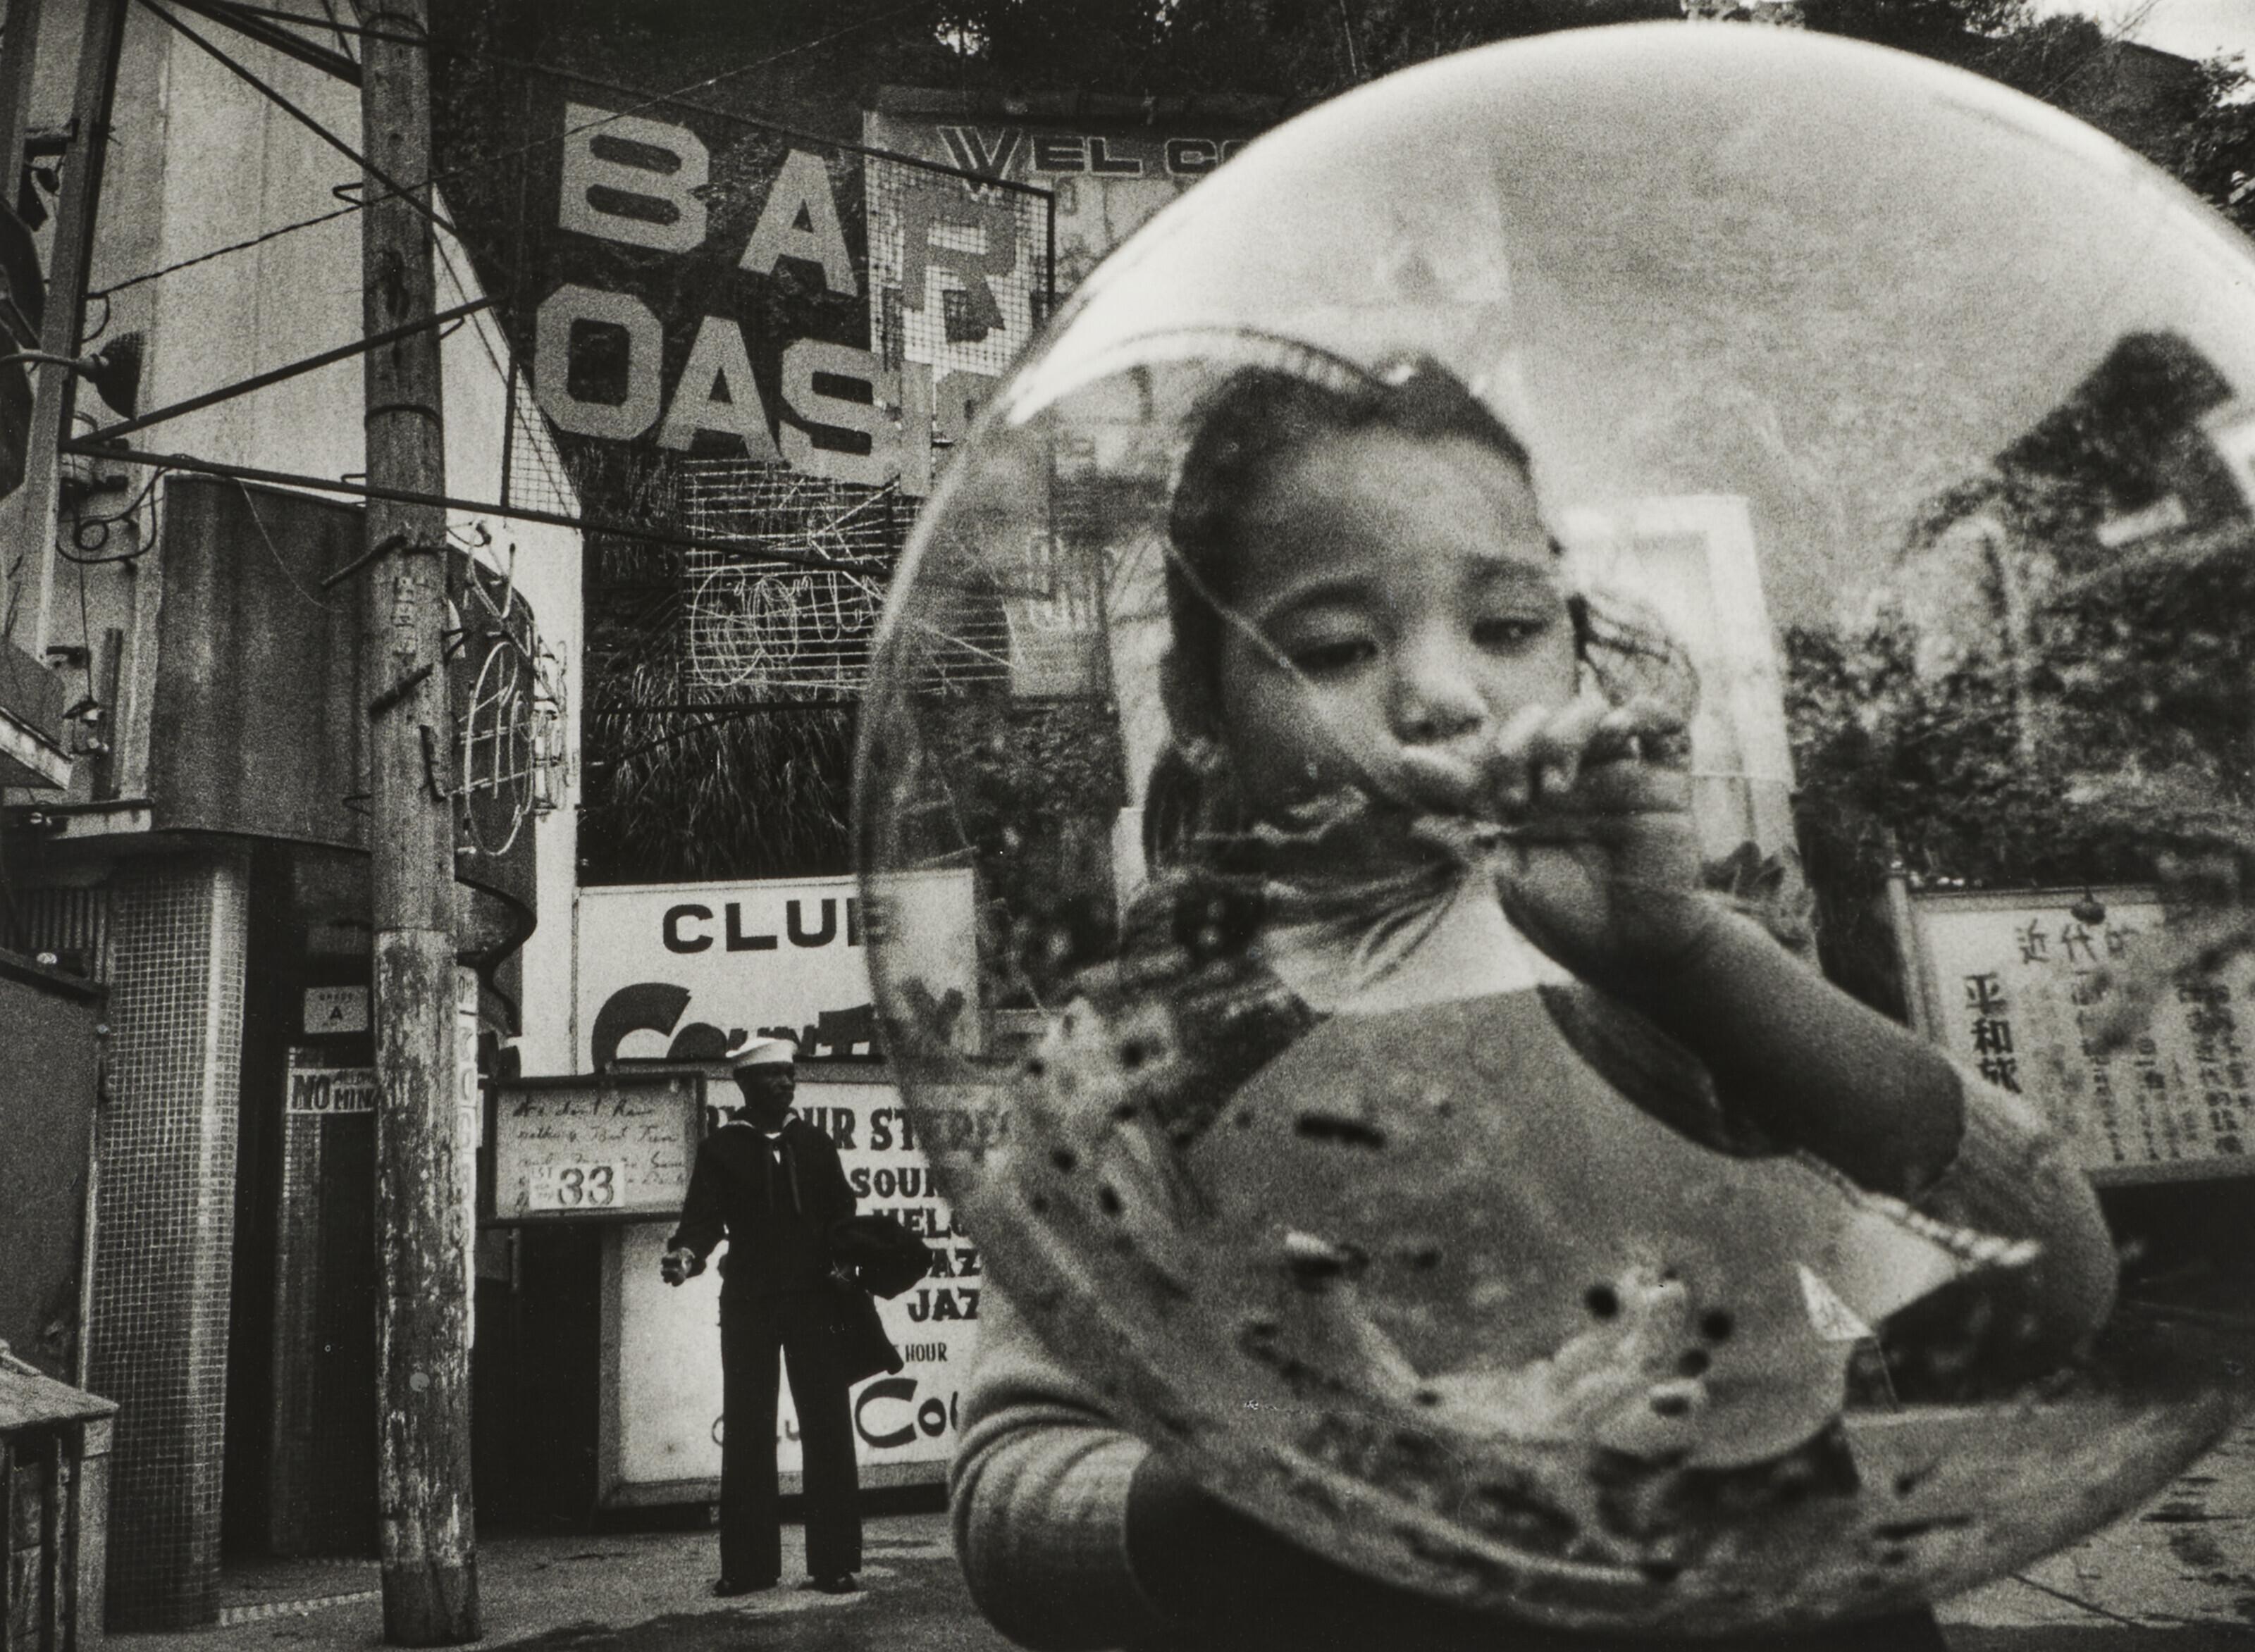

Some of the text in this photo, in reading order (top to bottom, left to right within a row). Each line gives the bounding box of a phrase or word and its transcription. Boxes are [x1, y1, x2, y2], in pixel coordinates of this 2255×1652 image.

[558, 101, 1017, 333] BAR
[292, 1074, 330, 1110] NO
[559, 1166, 614, 1205] 33
[905, 1343, 948, 1362] HOUR
